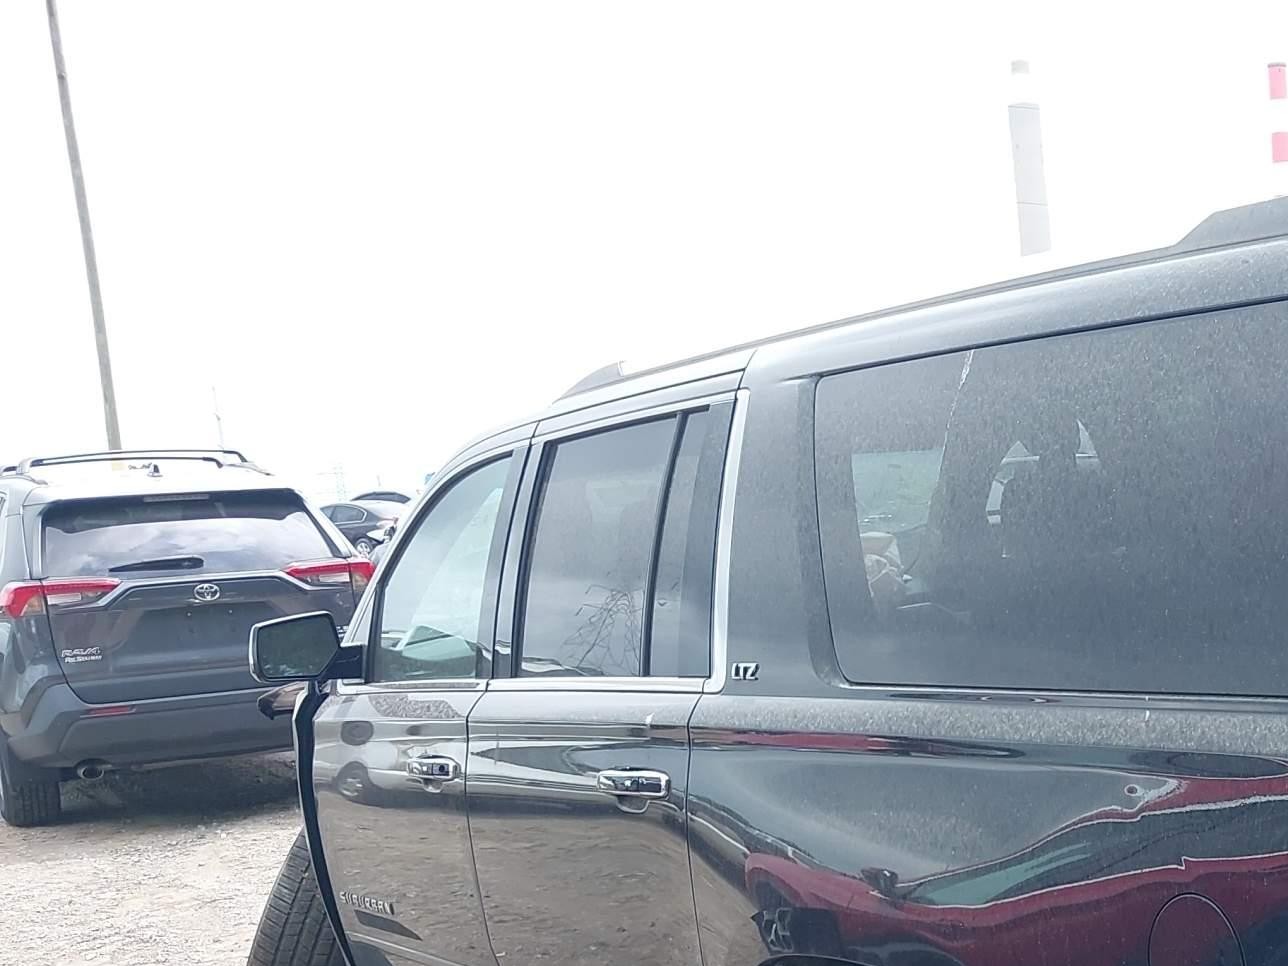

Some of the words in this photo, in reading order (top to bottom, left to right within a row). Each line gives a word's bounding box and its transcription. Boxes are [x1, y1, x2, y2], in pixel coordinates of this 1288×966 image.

[61, 646, 101, 658] RAV4
[731, 662, 760, 681] LTZ
[339, 891, 396, 916] SUBURBAN
